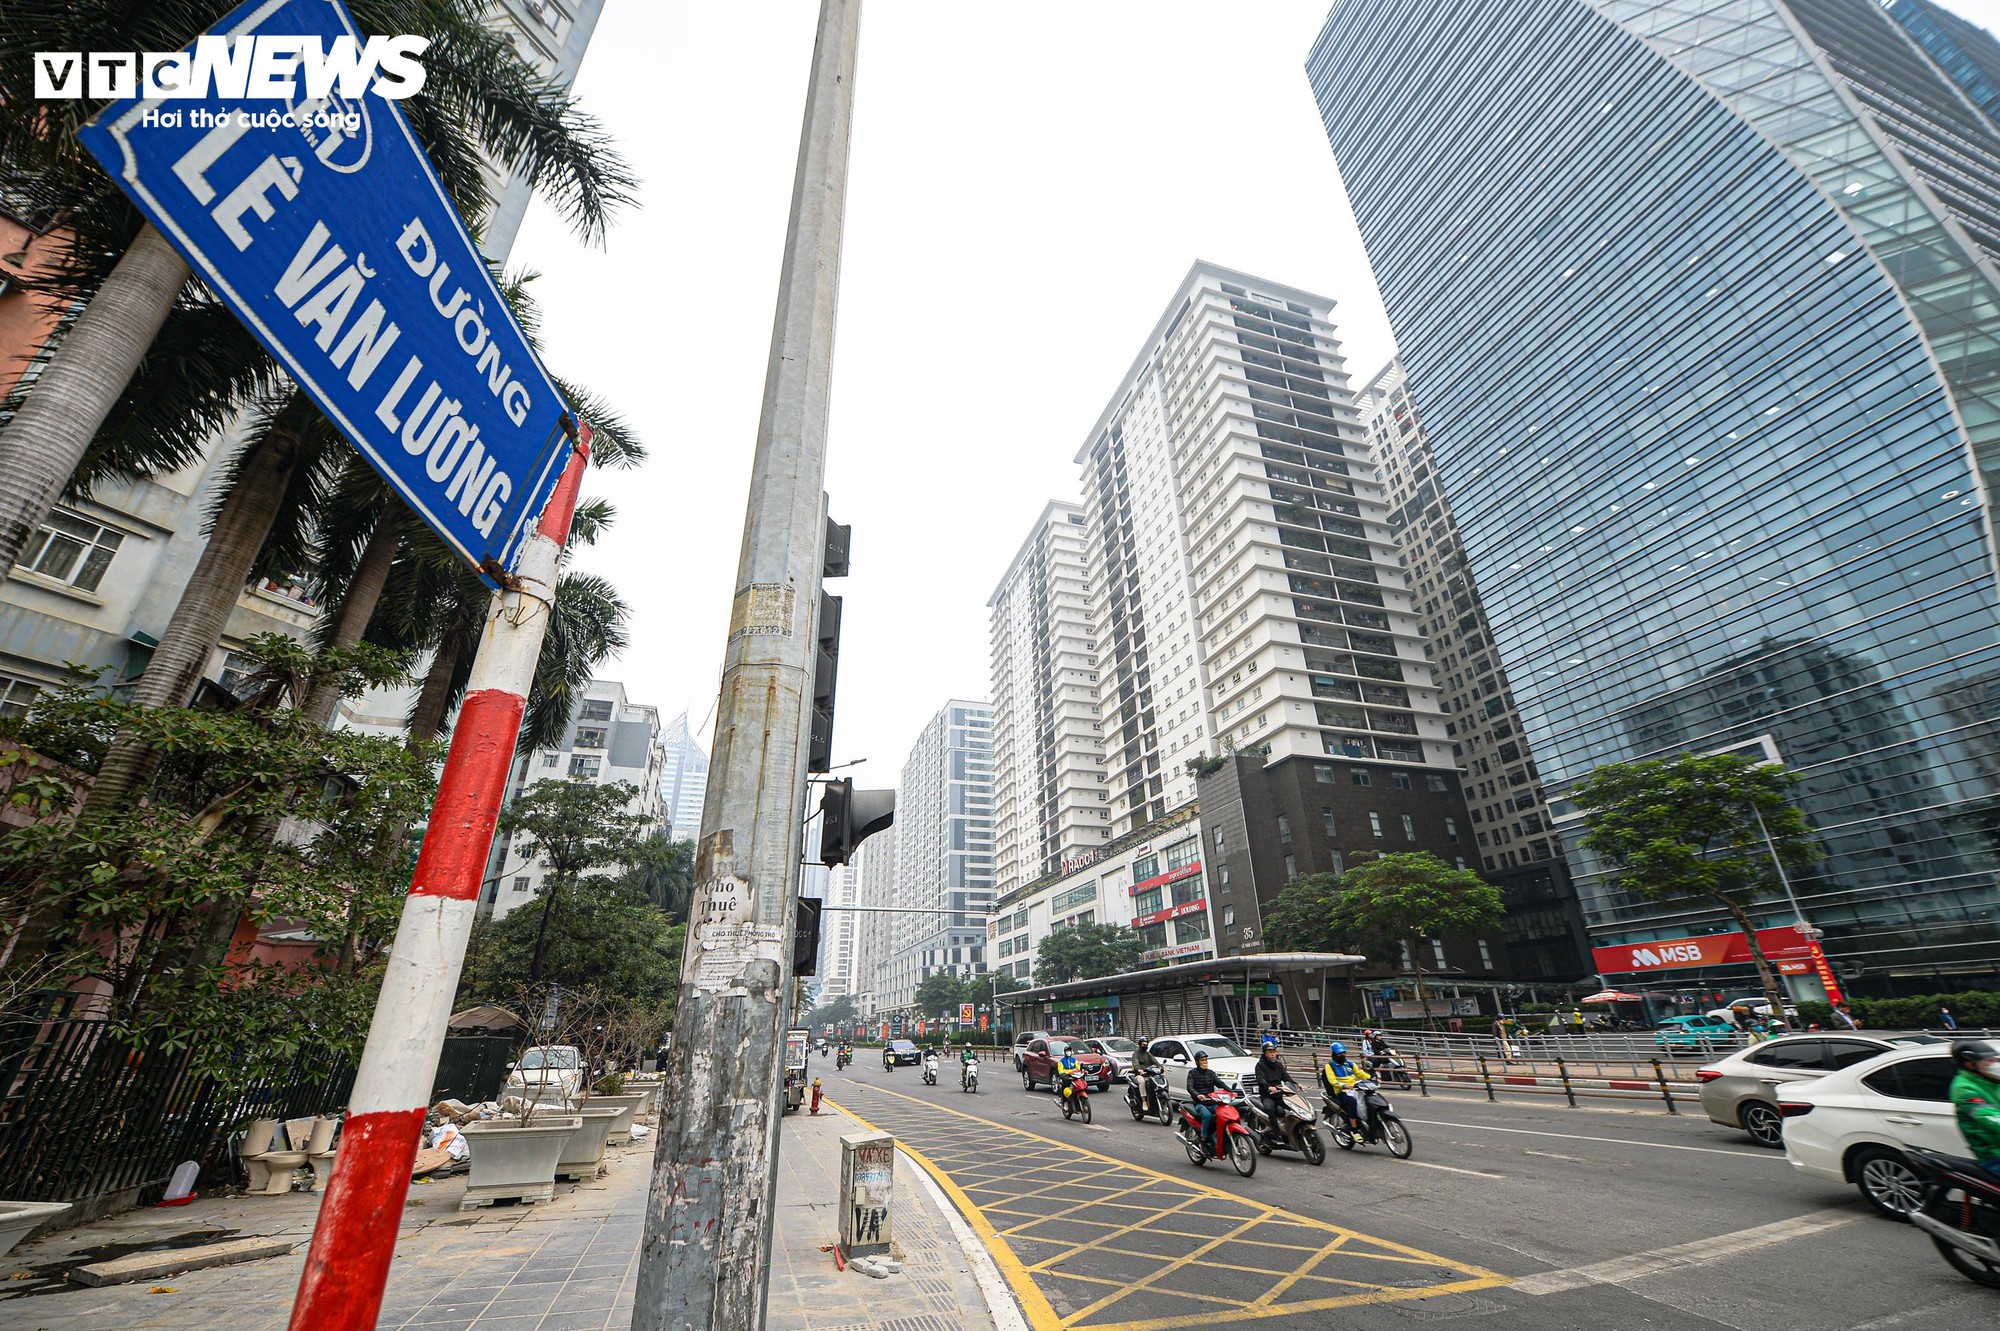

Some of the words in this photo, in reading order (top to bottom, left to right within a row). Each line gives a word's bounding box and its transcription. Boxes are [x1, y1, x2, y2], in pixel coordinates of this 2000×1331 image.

[171, 106, 304, 252] LÊ
[273, 220, 401, 392] VĂN
[375, 354, 513, 539] LƯƠNG
[396, 216, 531, 428] ĐƯỜNG
[705, 879, 735, 894] Cho
[700, 897, 737, 915] Thuê
[1243, 926, 1254, 940] 35
[1161, 949, 1175, 958] BANK
[1176, 944, 1201, 955] VIETNAM
[1658, 945, 1703, 964] MSB
